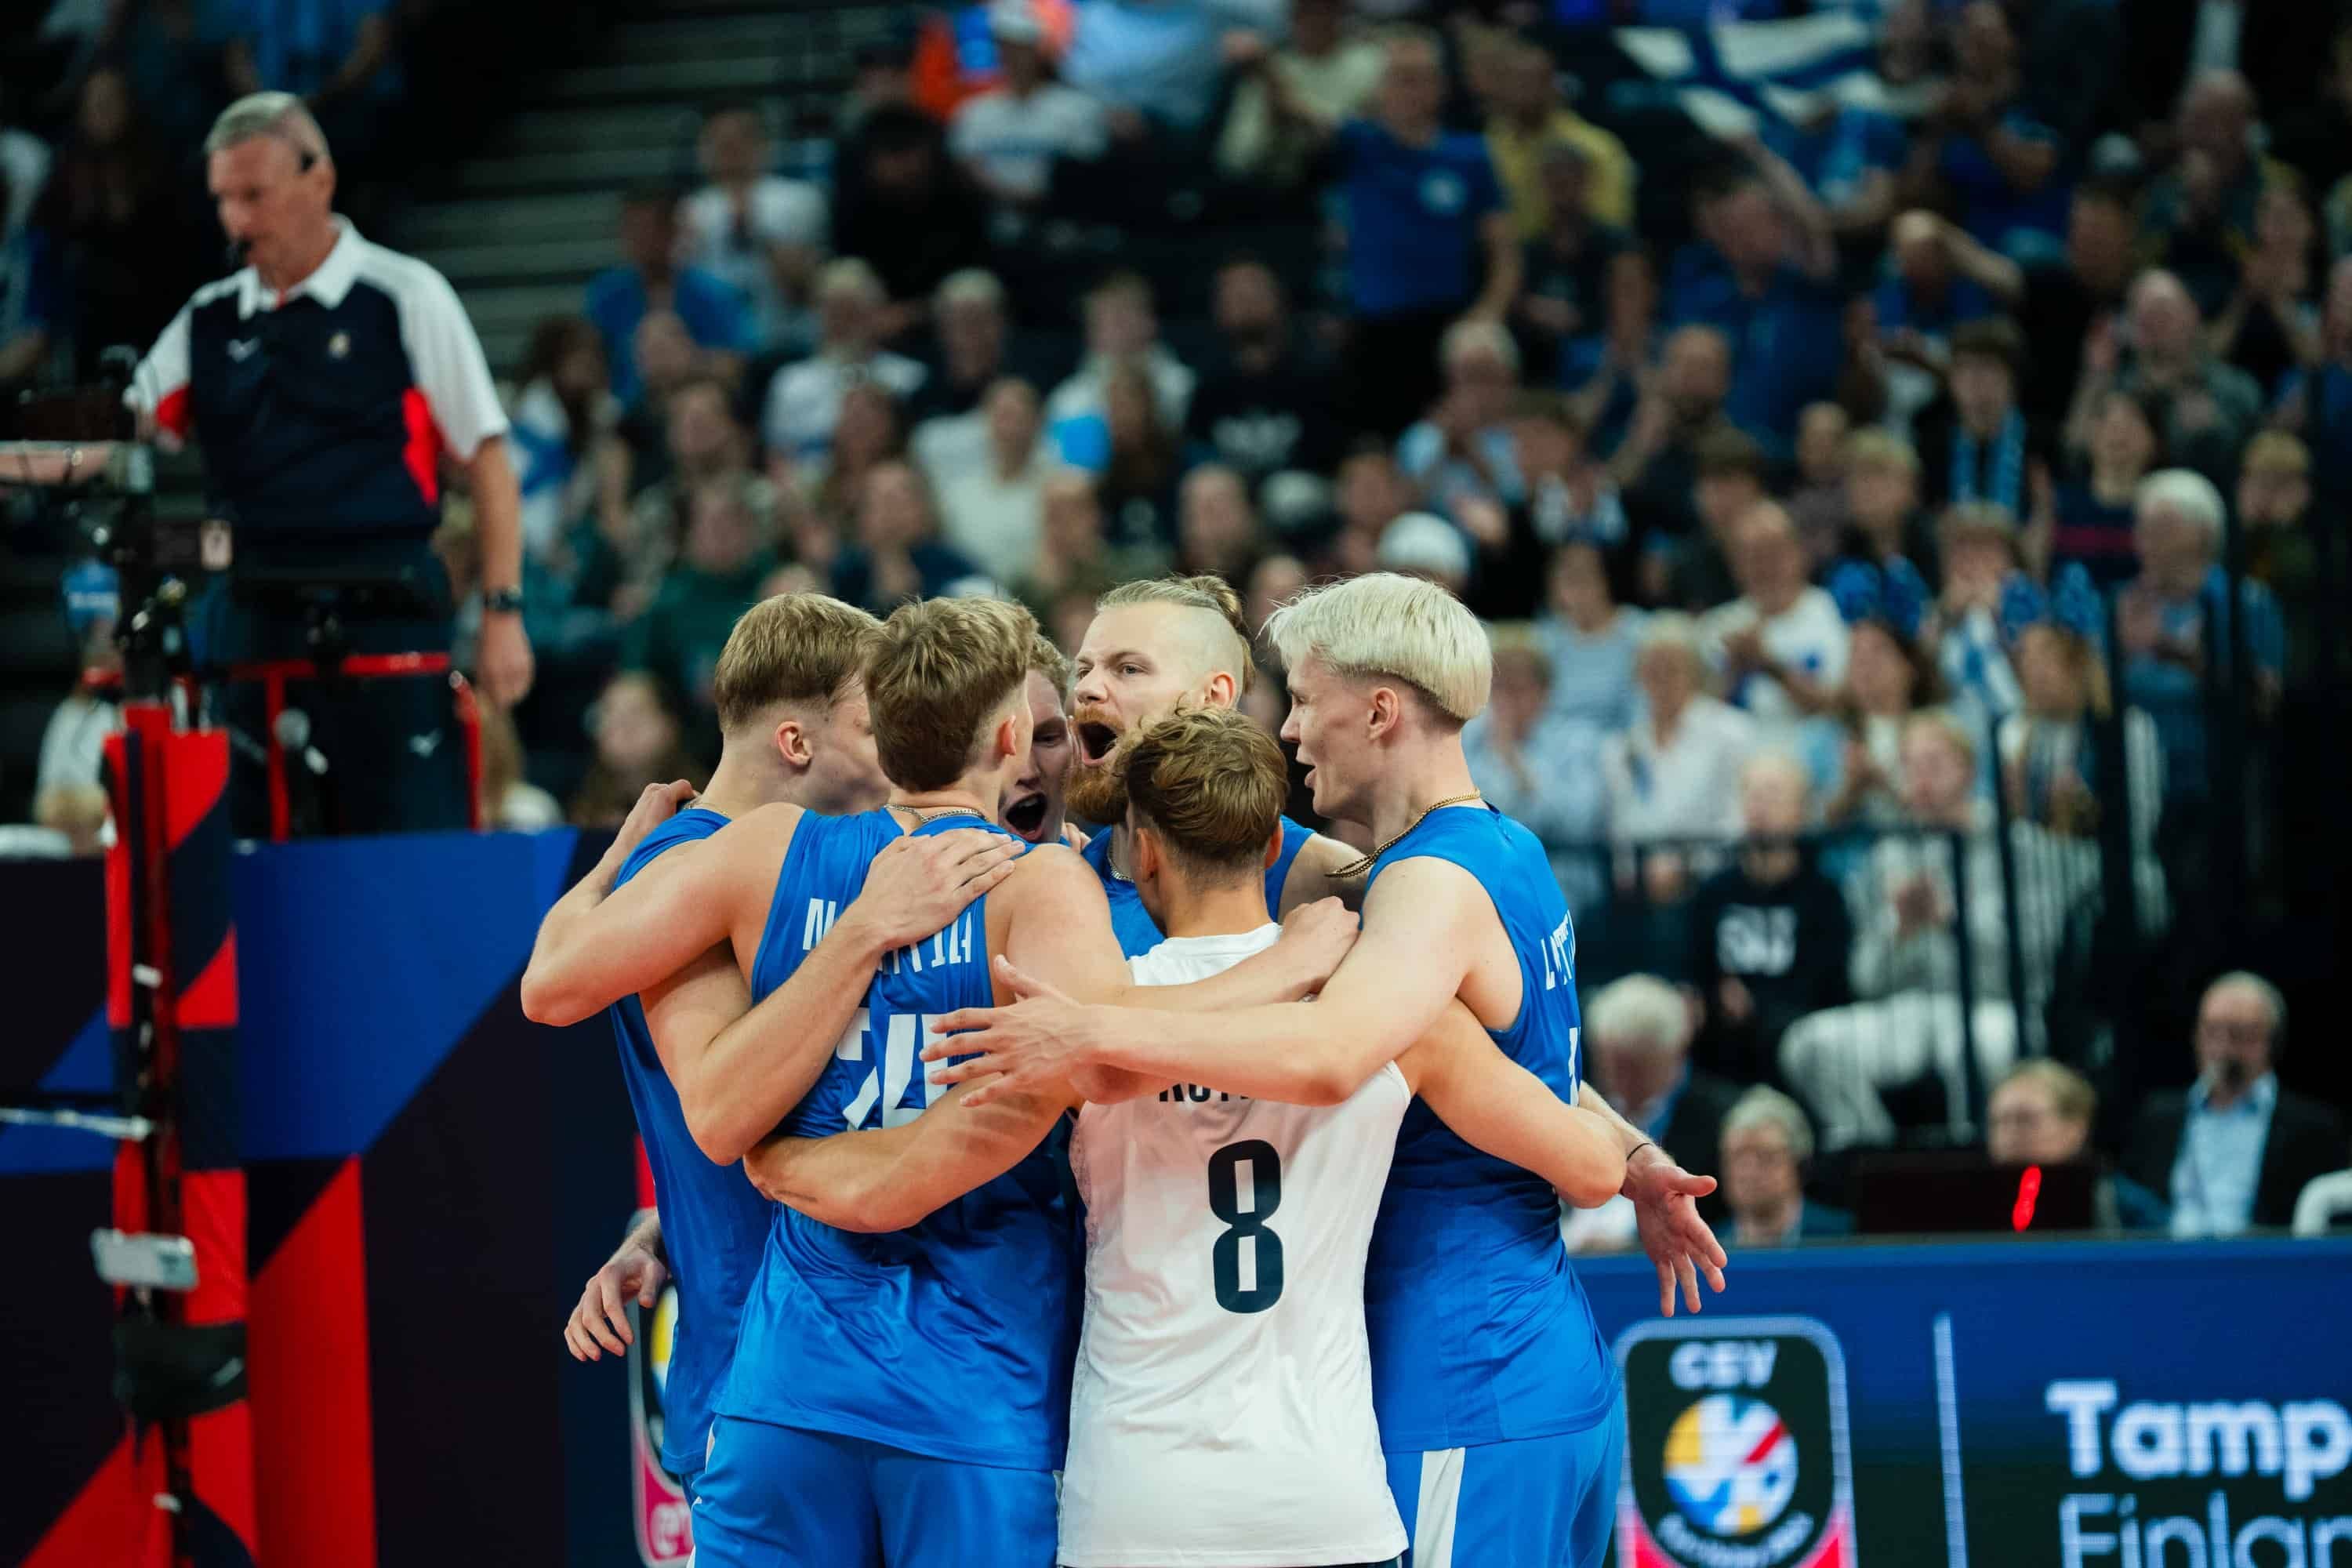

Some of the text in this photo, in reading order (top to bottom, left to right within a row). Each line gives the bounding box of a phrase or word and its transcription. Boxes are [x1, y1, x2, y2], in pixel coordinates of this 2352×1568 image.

[1208, 1139, 1284, 1314] 8
[1668, 1340, 1778, 1390] CEV
[2045, 1377, 2352, 1502] Tamp
